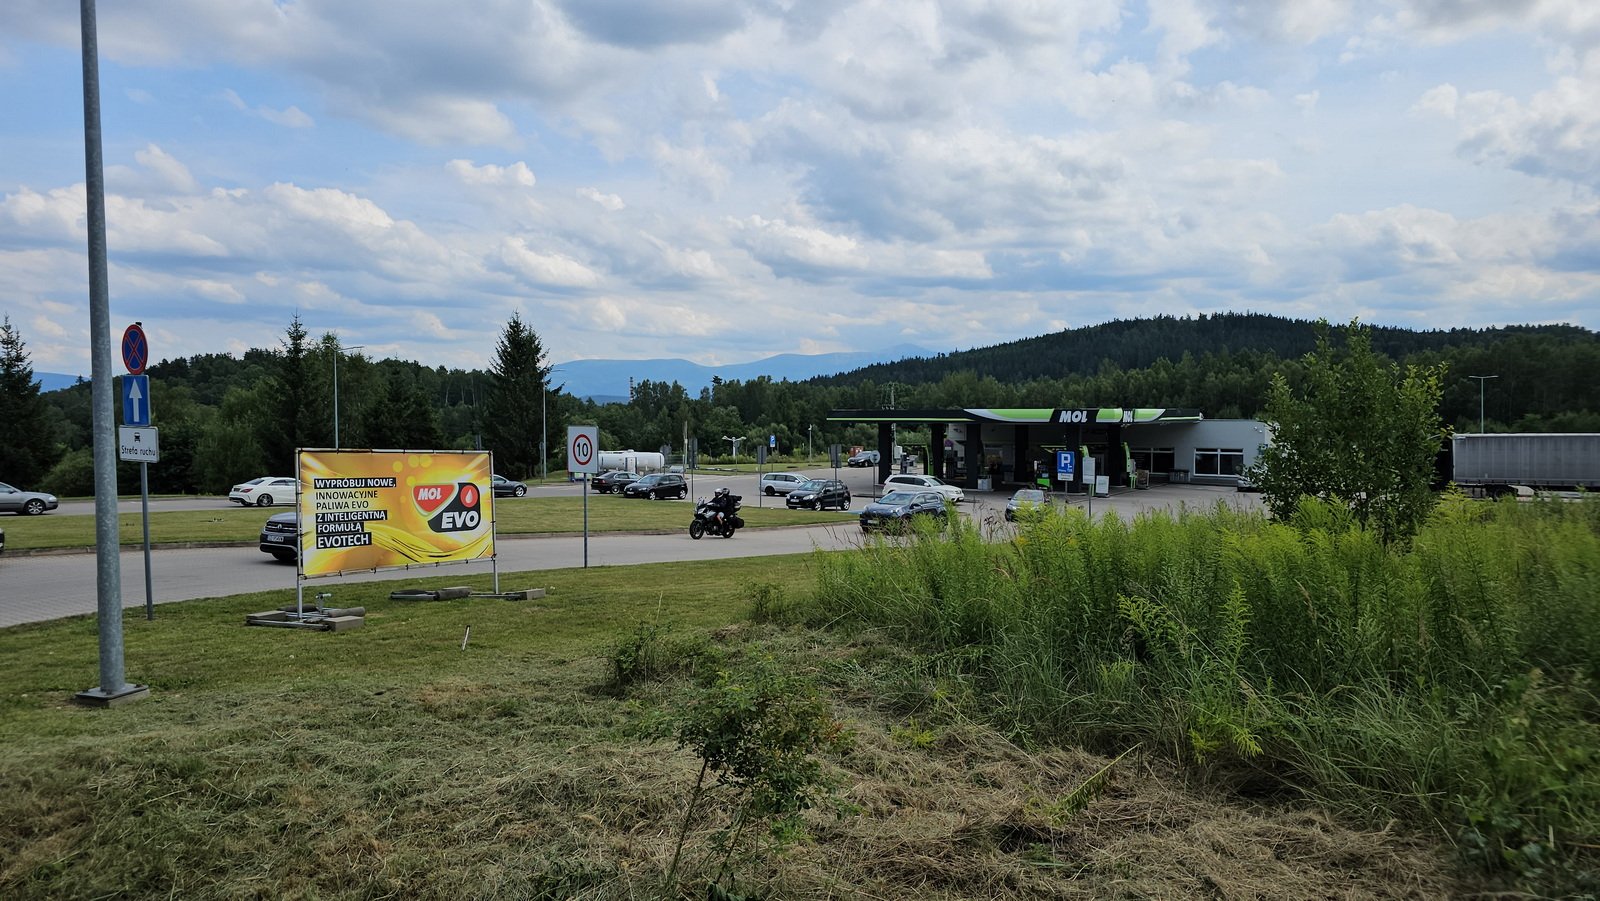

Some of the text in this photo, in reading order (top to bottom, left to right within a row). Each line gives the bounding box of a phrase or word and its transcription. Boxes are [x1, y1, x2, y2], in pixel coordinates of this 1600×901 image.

[1059, 410, 1088, 422] MOL
[121, 445, 156, 456] Strefa ruchu
[576, 442, 589, 457] 10
[1061, 453, 1071, 467] P
[315, 478, 396, 488] WYPRÓBUJ NOWE,
[315, 490, 378, 500] INNOWACYJNE
[417, 487, 443, 500] MOL
[316, 500, 369, 510] PALIWA EVO
[317, 511, 386, 522] Z INTELIGENTNĄ
[441, 510, 479, 529] EVO
[317, 522, 362, 533] FORMUŁĄ
[317, 533, 369, 548] EVOTECH
